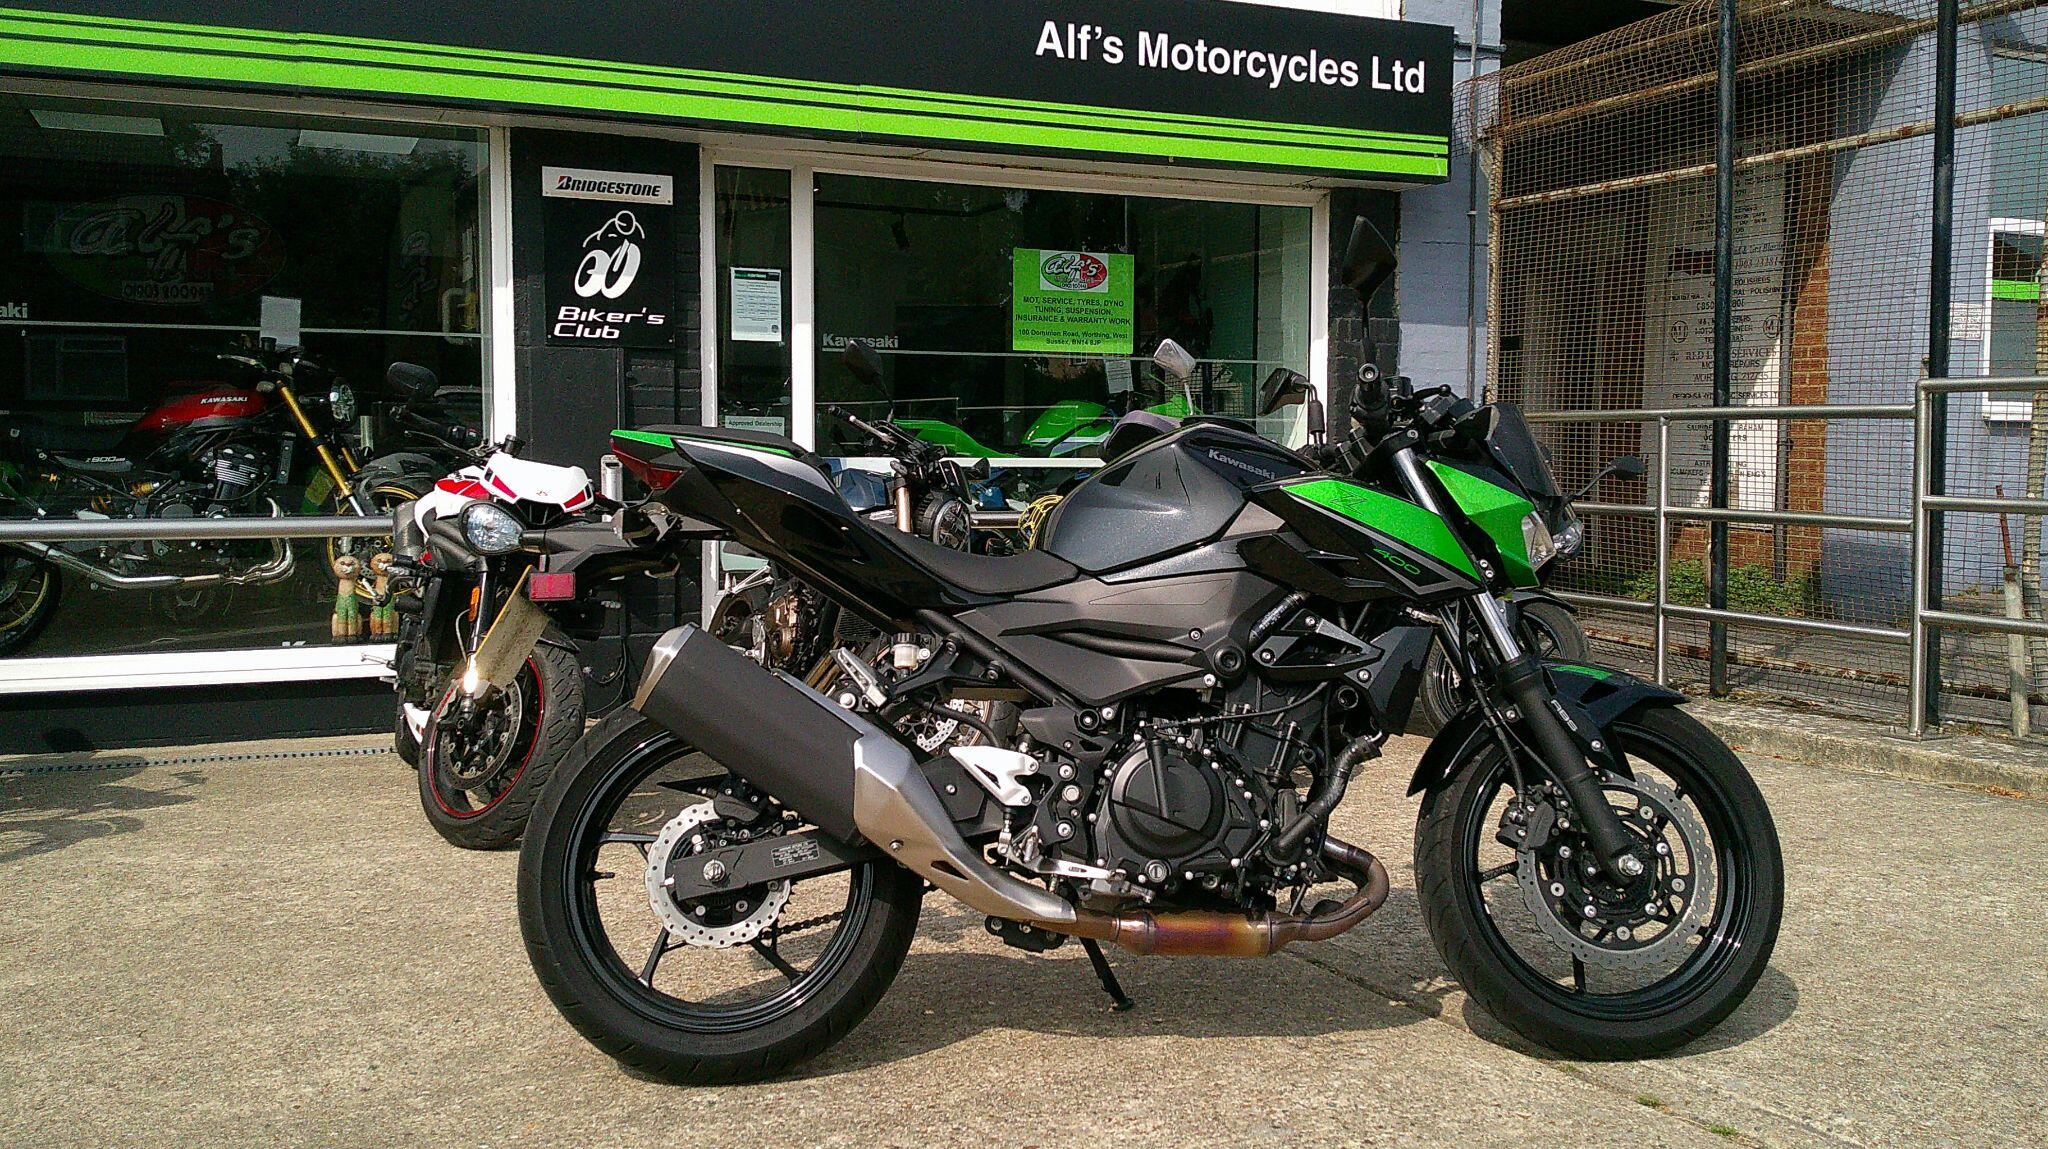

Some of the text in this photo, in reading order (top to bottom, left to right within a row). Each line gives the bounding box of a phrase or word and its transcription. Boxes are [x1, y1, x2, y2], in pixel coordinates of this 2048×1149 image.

[1035, 20, 1427, 94] Alf's Motorcycles Ltd
[555, 175, 662, 197] BRIDGESTONE
[557, 305, 666, 326] Biker's
[1015, 314, 1057, 323] INSURANCE
[1067, 316, 1107, 325] WARRANTY
[1109, 318, 1131, 326] WORK
[553, 322, 621, 340] Club
[200, 396, 248, 404] KAWASAKI
[1208, 448, 1276, 480] Kawasaki
[1372, 547, 1421, 576] 400
[1550, 699, 1578, 732] ABS
